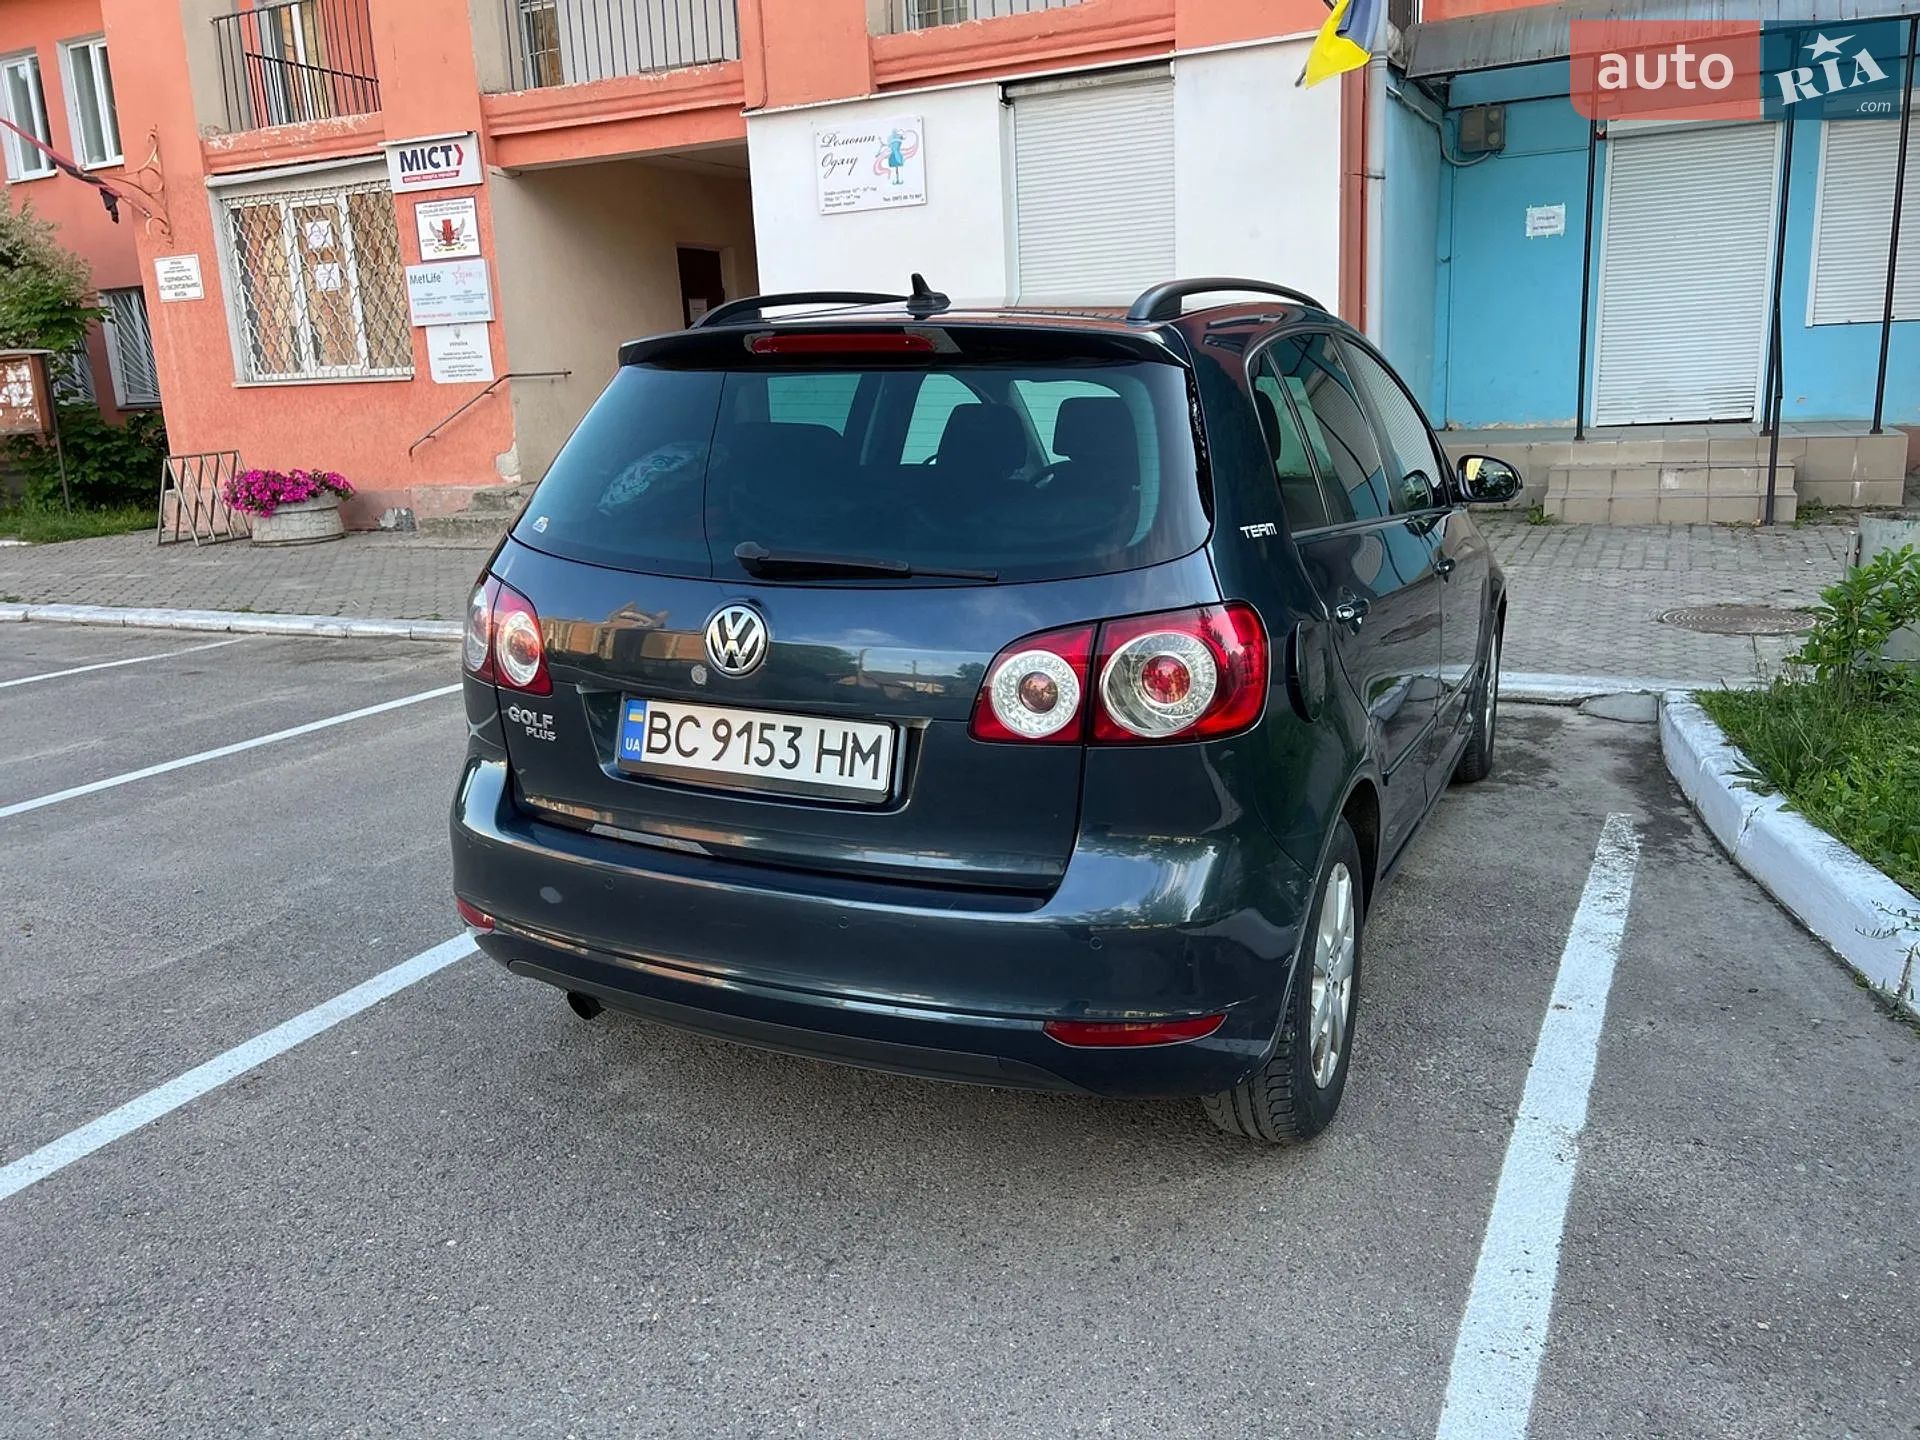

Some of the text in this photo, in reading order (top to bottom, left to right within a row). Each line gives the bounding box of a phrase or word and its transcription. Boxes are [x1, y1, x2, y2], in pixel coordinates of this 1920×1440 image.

[399, 145, 452, 172] МІСТ
[409, 271, 441, 285] MetLife
[1240, 522, 1277, 539] TEAM
[508, 705, 553, 729] GOLF
[525, 726, 556, 741] PLUS
[625, 737, 640, 751] UA
[646, 711, 883, 780] BC 9153 HM
